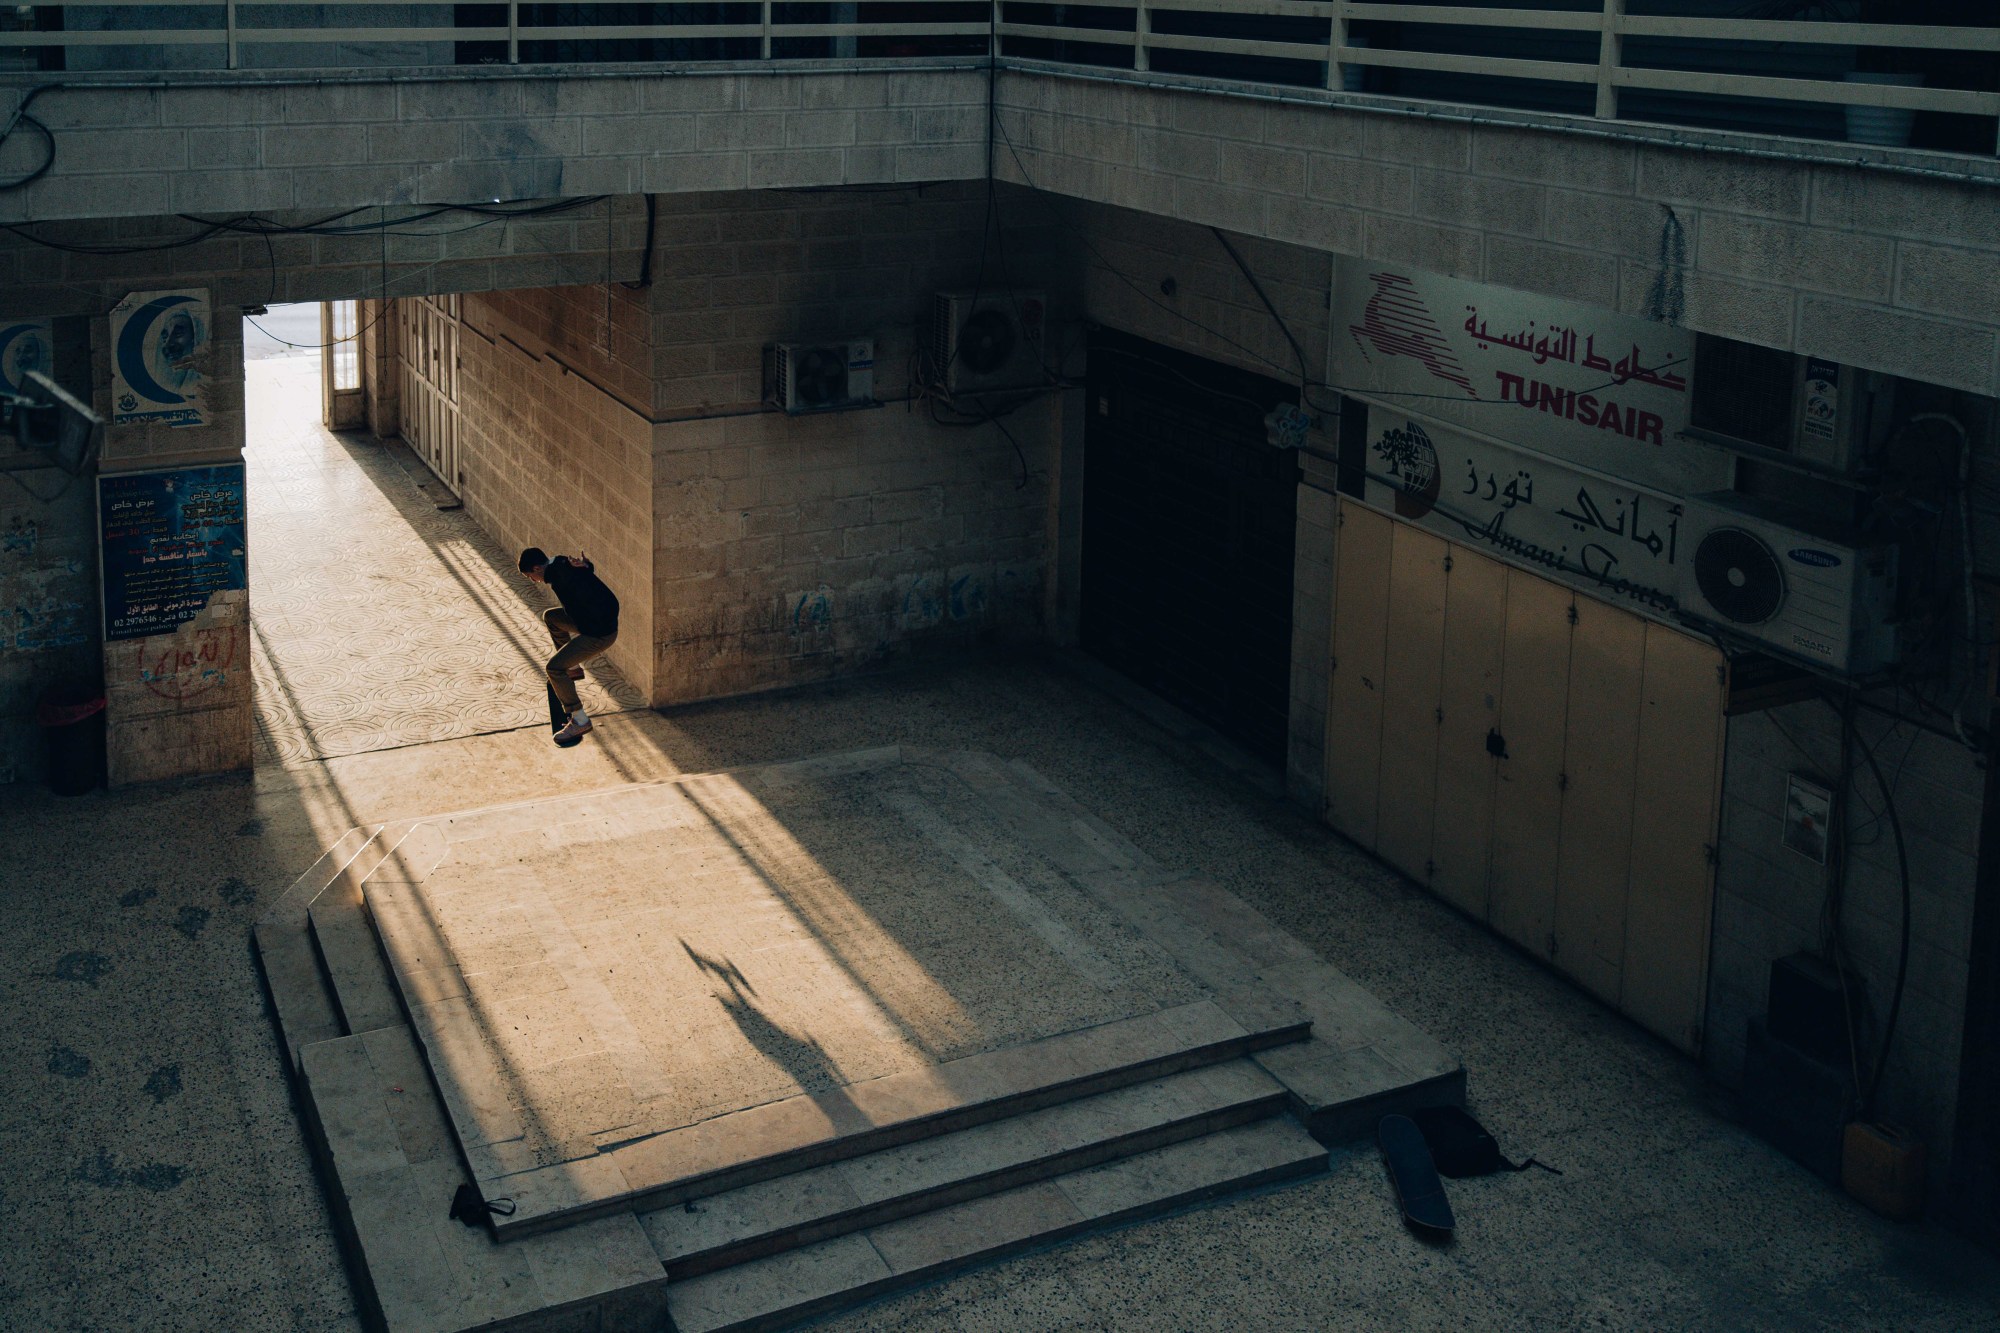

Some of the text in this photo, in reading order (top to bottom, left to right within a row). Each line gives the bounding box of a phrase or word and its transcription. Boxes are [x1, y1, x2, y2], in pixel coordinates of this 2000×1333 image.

[1464, 305, 1577, 364] التونسية
[1496, 371, 1664, 446] TUNISAIR
[190, 488, 233, 501] عرض خاص
[112, 499, 155, 511] عرض خاص
[1462, 458, 1683, 564] أماني تورز
[158, 552, 184, 562] منافسة
[1795, 549, 1835, 568] SAMSUNG
[186, 599, 203, 607] عمارة
[114, 619, 124, 628] 02
